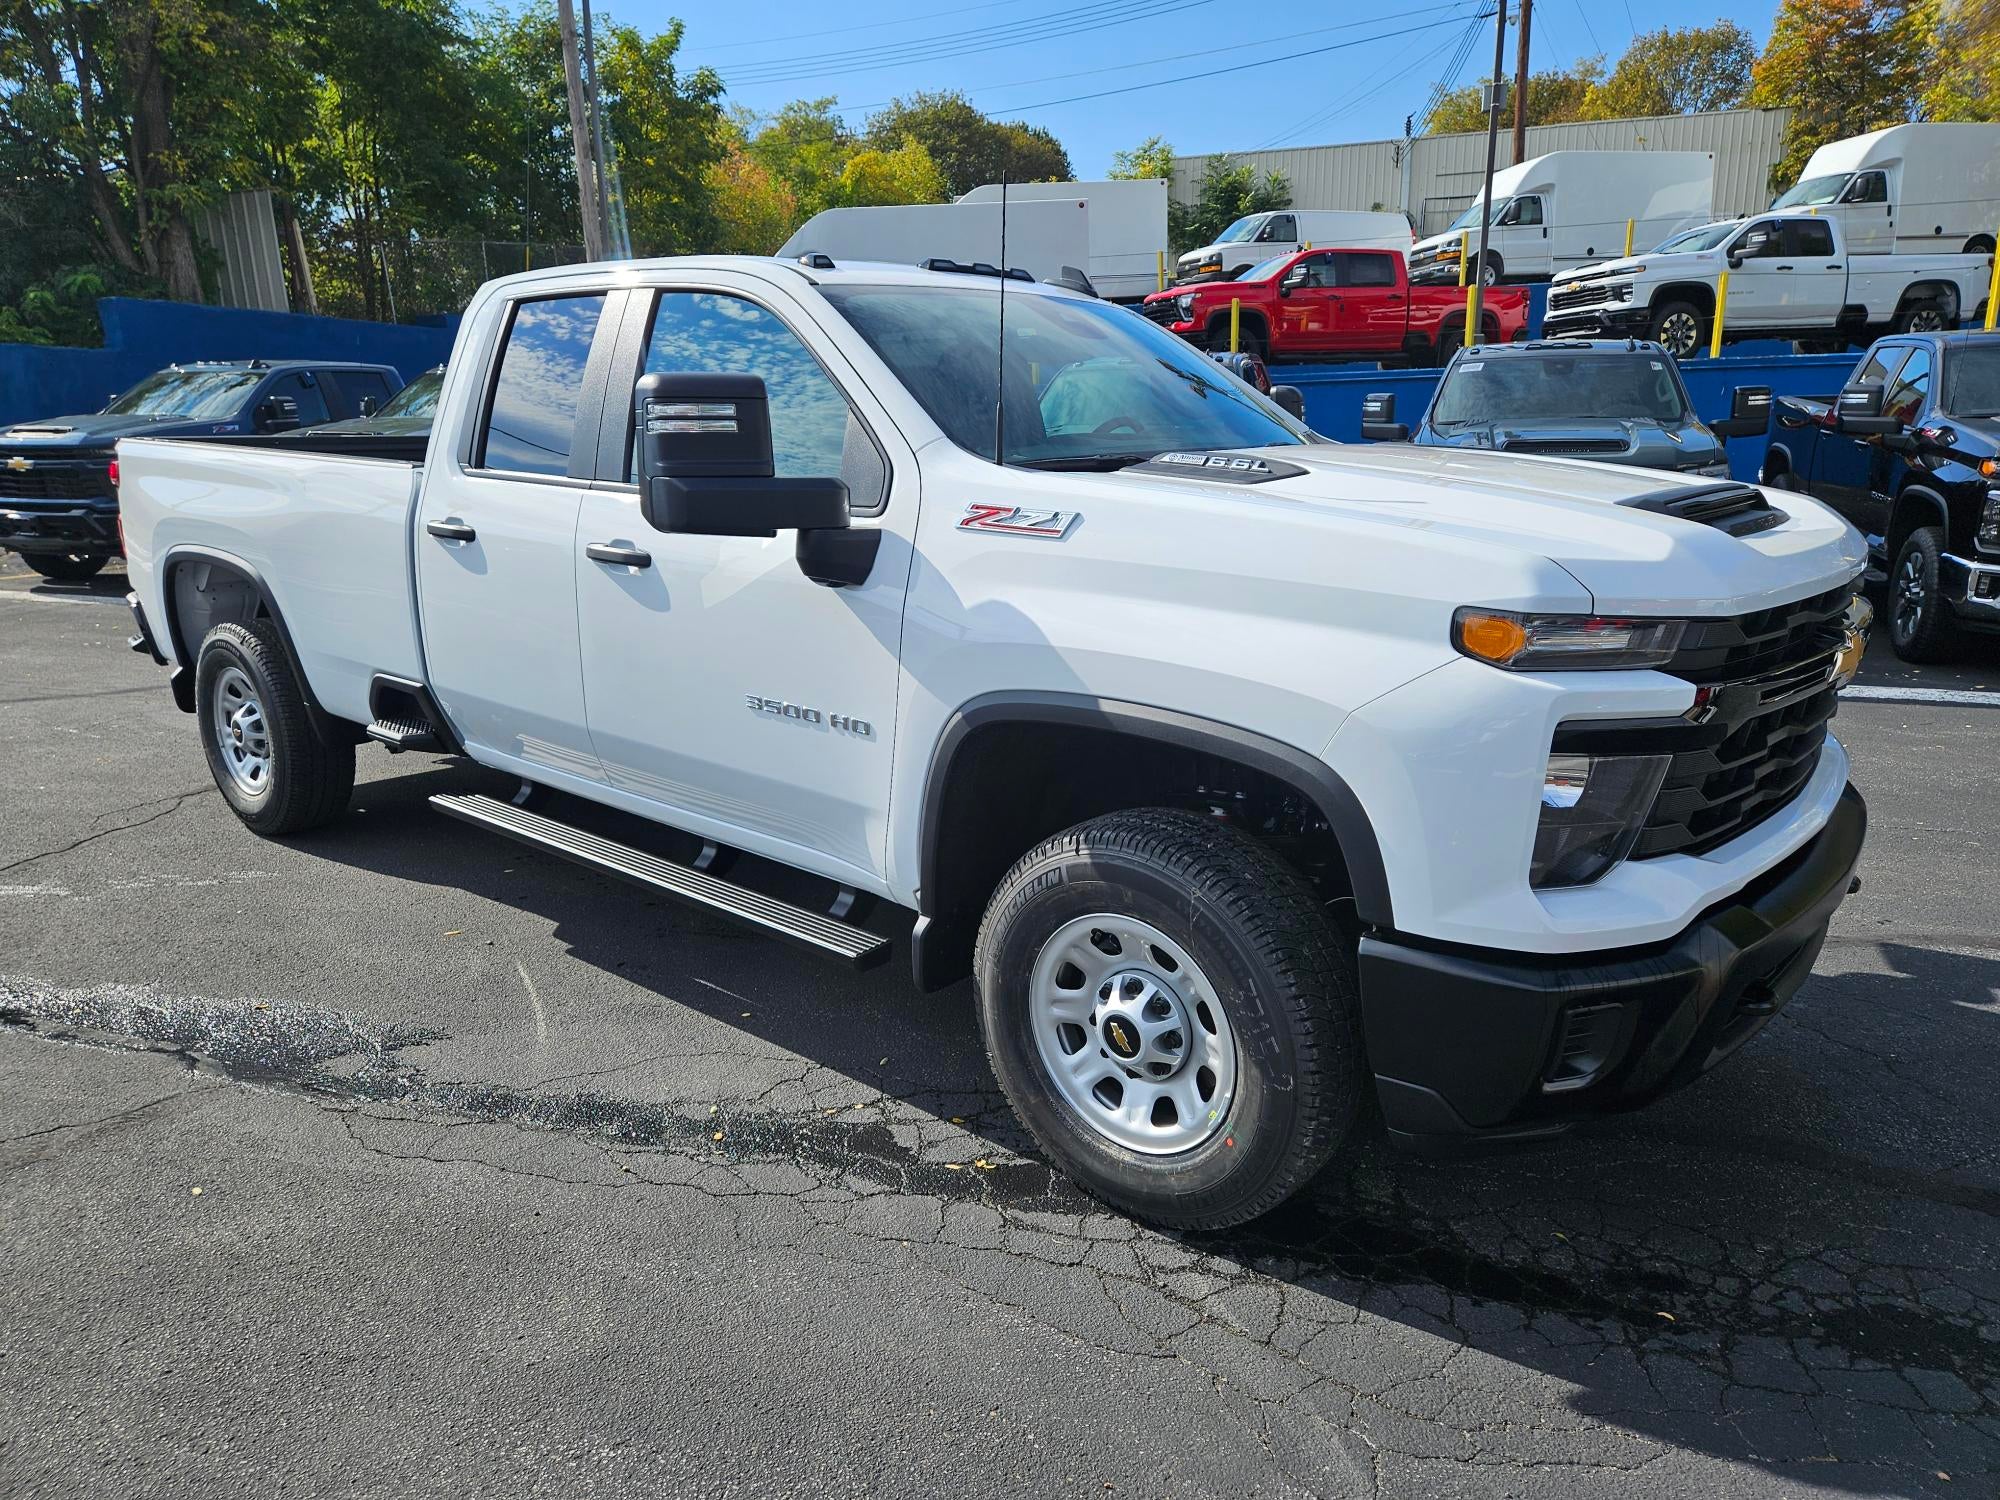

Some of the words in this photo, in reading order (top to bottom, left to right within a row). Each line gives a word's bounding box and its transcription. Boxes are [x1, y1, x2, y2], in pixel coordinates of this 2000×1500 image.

[1206, 456, 1270, 473] 6.6L
[955, 502, 1083, 539] Z71
[745, 694, 821, 723] 3500
[830, 712, 871, 736] HD
[994, 867, 1060, 937] MICHELIN
